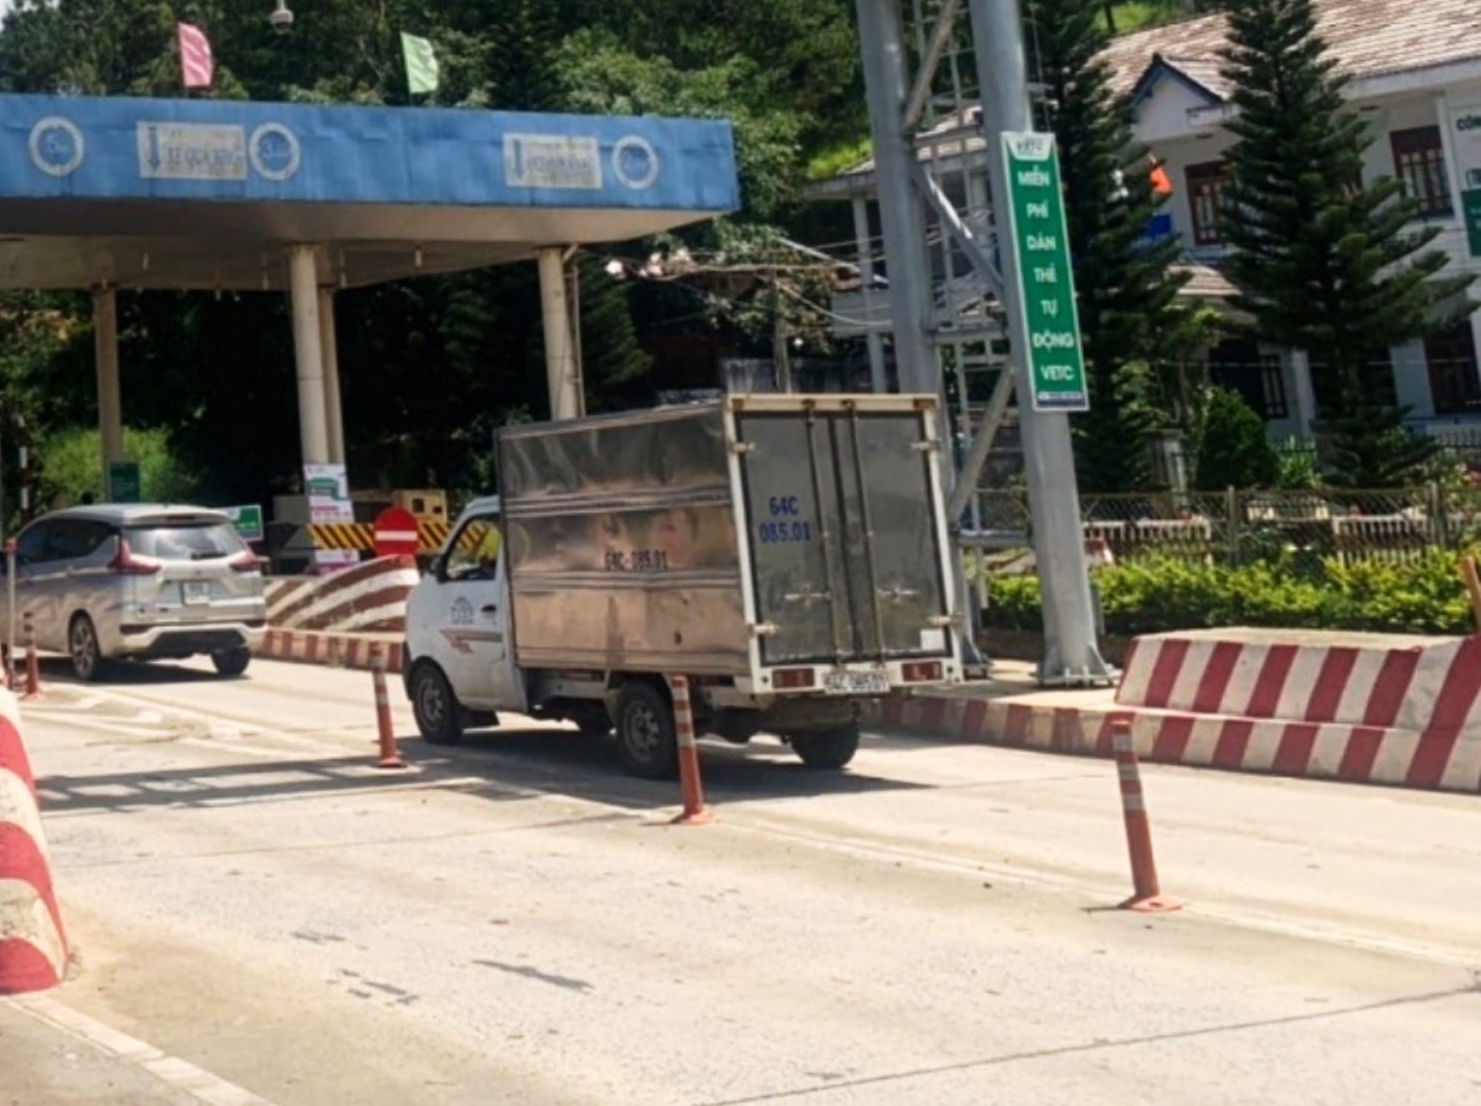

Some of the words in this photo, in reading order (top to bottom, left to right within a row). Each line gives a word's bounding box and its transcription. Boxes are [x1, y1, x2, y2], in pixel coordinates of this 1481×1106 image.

[1026, 199, 1049, 218] PHÍ
[1040, 364, 1076, 381] VETC
[769, 495, 799, 515] 64C
